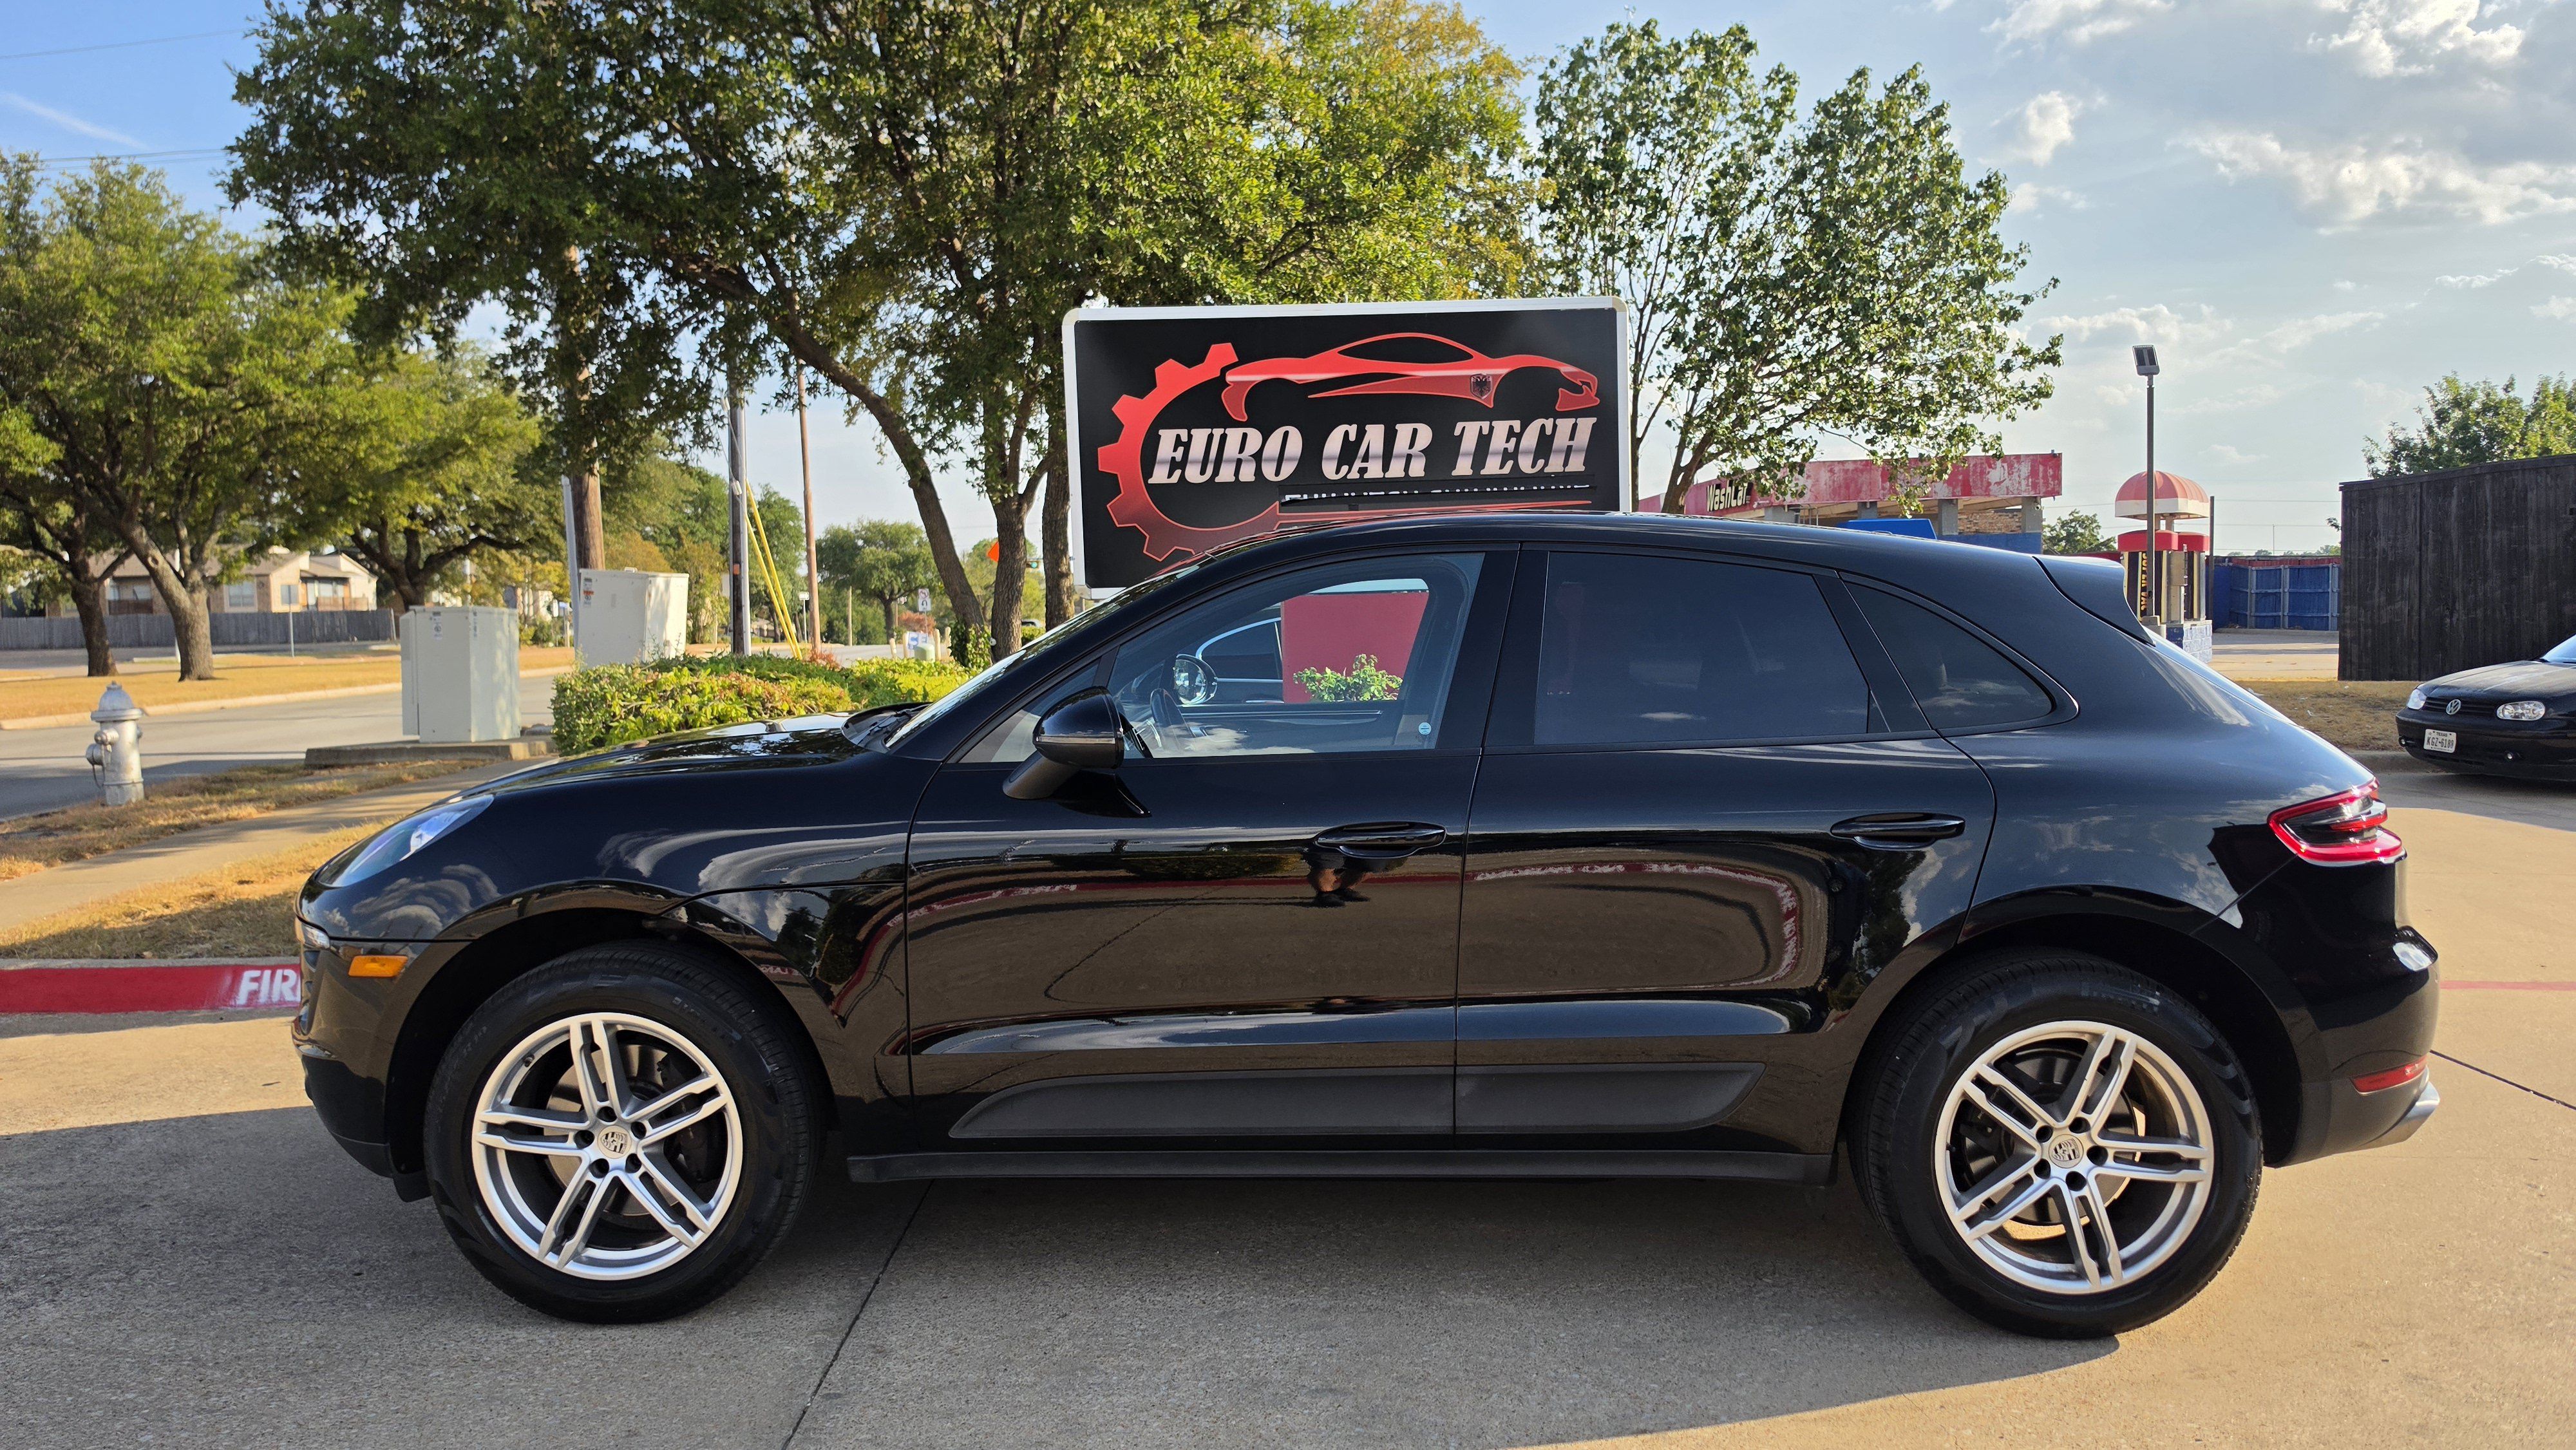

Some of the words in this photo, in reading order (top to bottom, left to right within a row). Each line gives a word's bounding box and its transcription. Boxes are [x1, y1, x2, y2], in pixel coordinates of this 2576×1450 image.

[1148, 426, 1302, 484] EURO
[1322, 423, 1432, 480] CAR
[1452, 417, 1597, 476] TECH
[236, 969, 301, 1005] FIR
